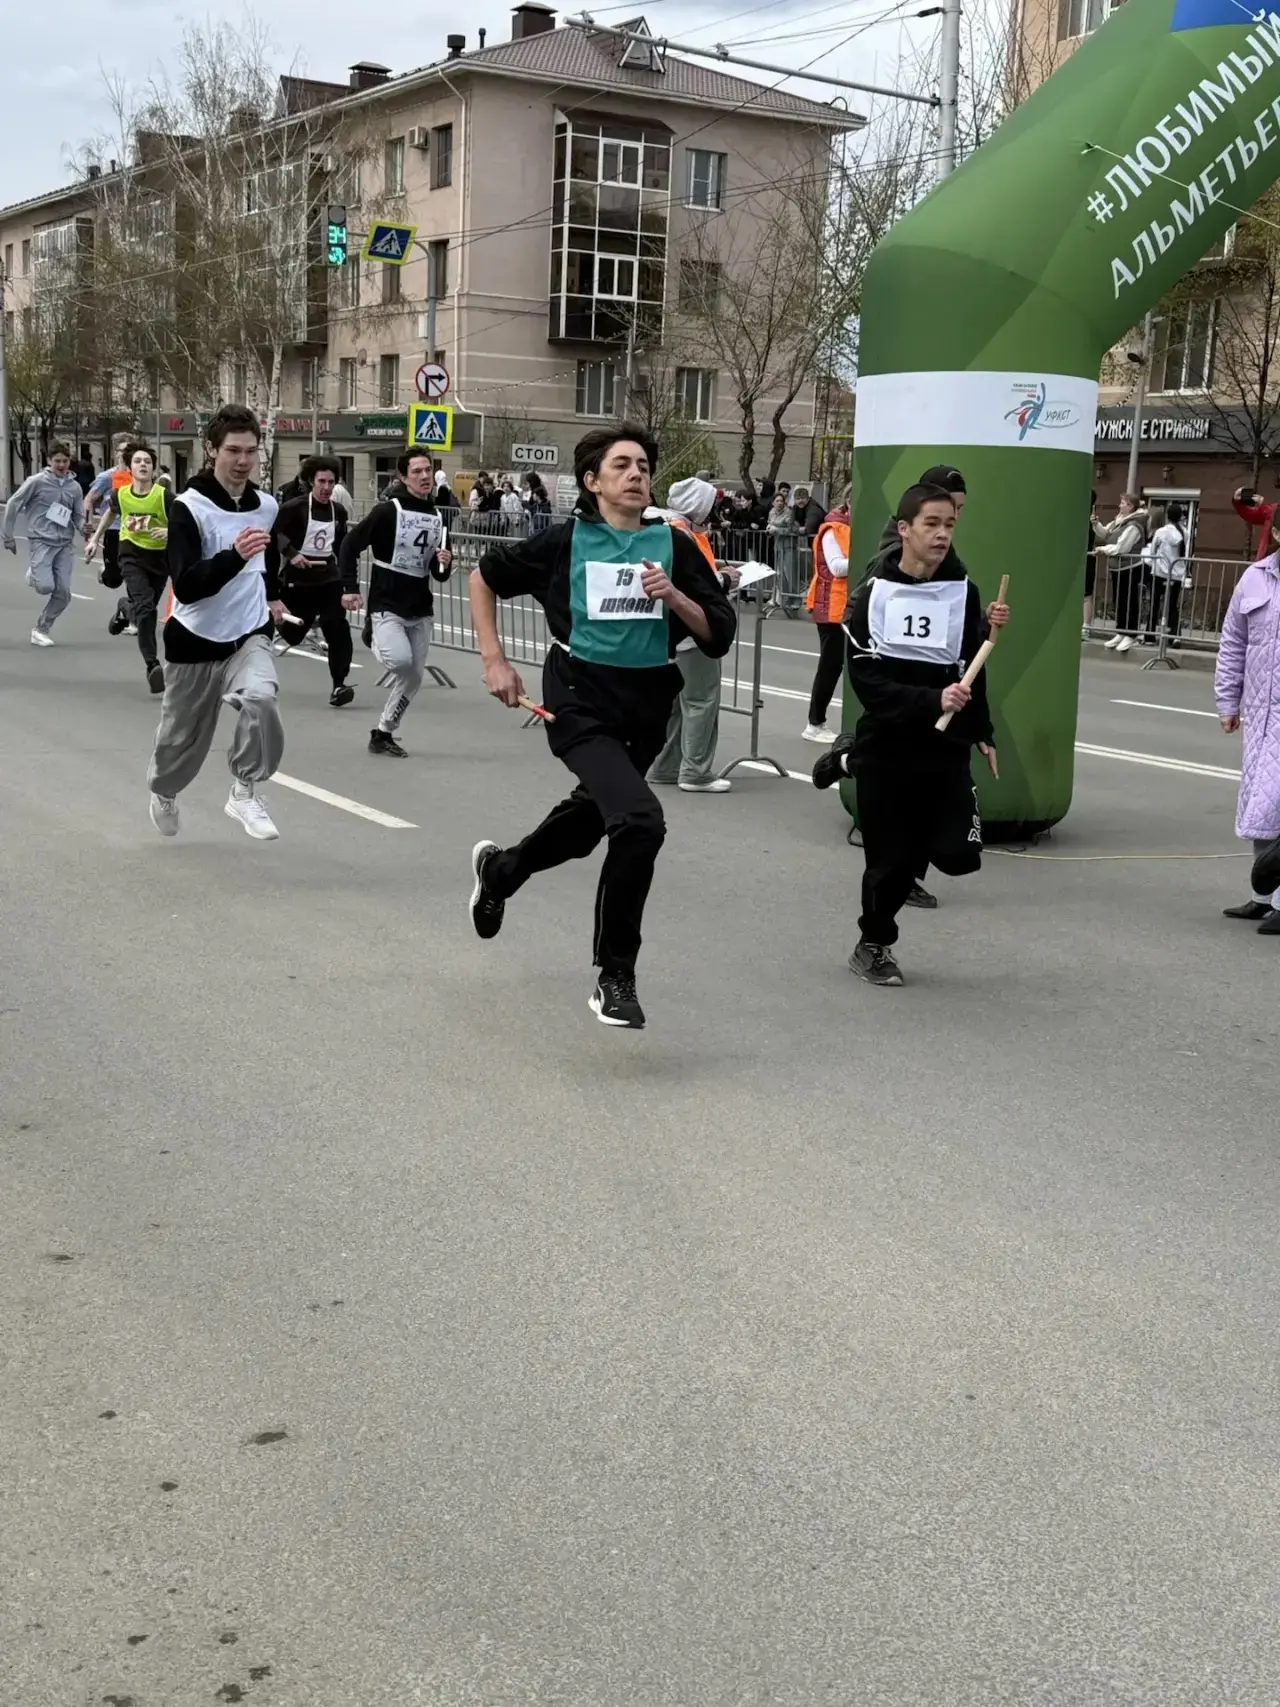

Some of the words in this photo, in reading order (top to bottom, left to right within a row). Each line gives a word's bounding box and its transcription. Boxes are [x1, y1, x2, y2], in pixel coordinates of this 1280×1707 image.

[328, 225, 346, 244] 34
[1094, 419, 1148, 439] МУЖСКЕ
[515, 447, 554, 461] СТОП
[314, 529, 327, 551] 6
[413, 529, 429, 555] 4
[616, 568, 634, 586] 15
[903, 614, 931, 638] 13
